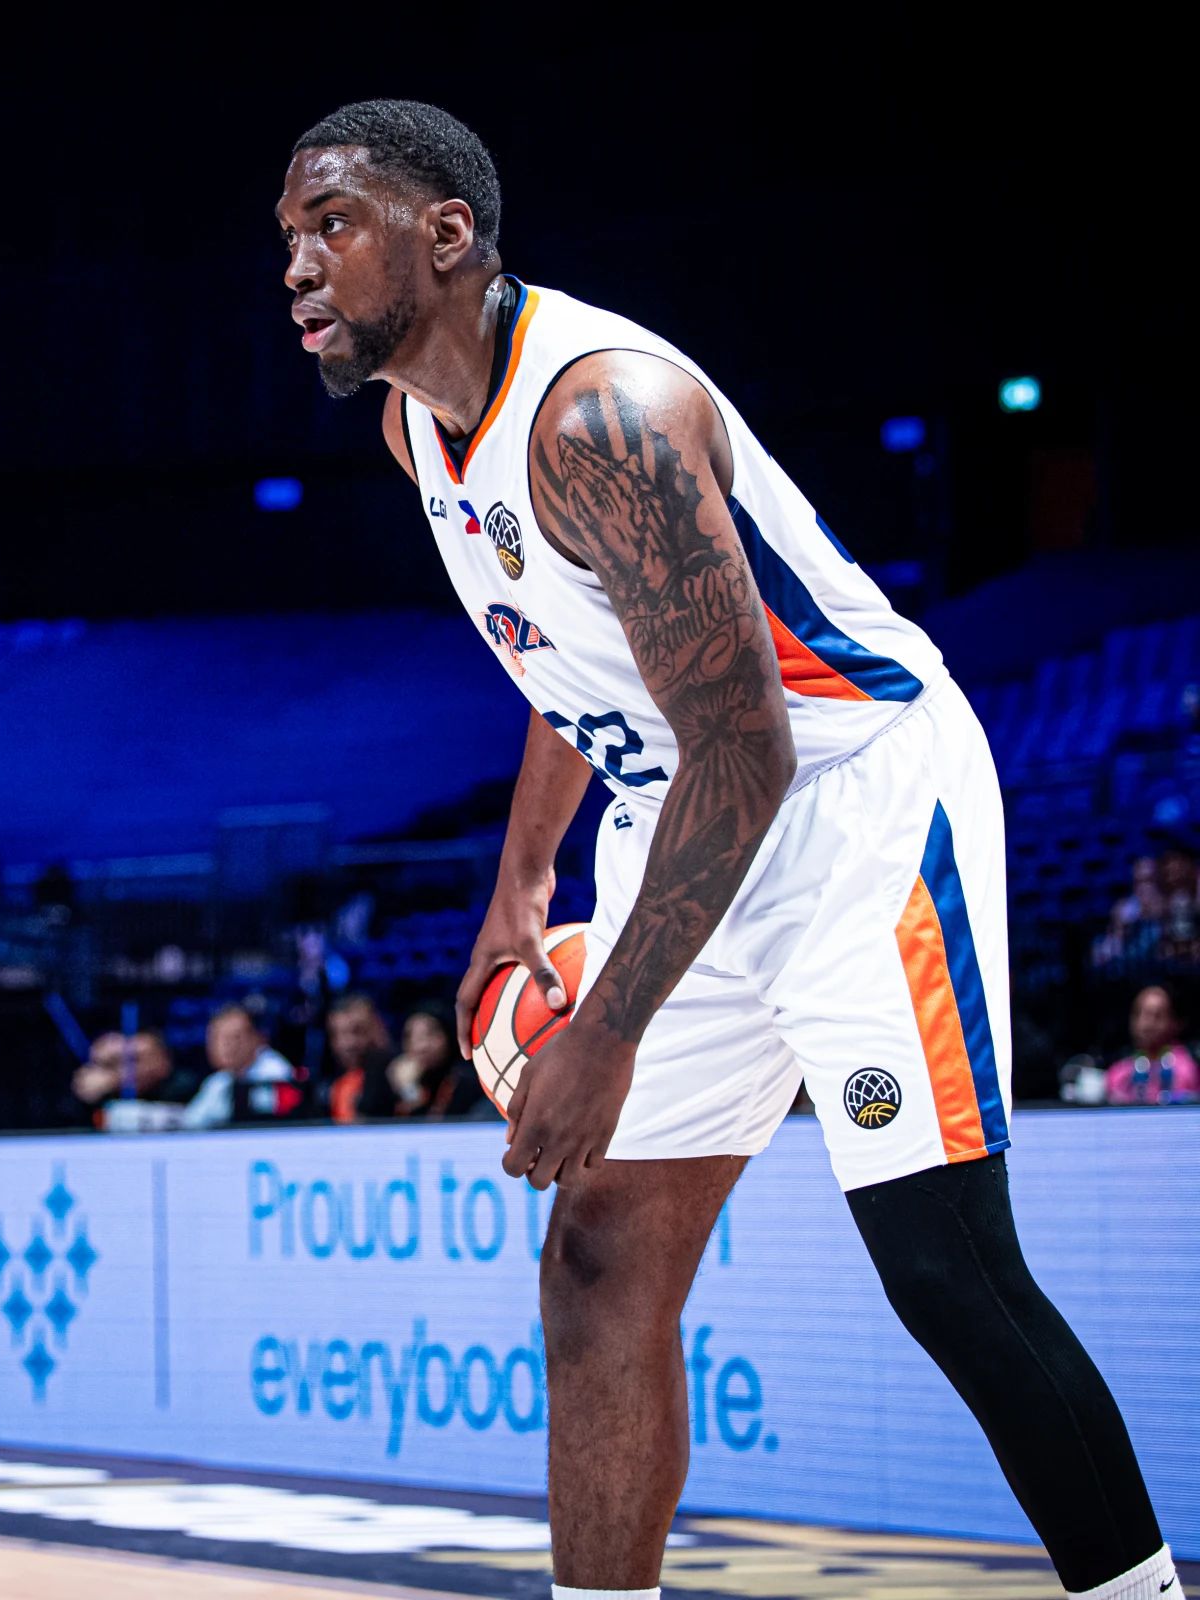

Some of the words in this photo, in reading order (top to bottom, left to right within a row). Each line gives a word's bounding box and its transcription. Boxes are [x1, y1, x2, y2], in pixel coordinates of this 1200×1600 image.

[249, 1154, 420, 1260] Proud
[440, 1158, 506, 1262] to
[251, 1314, 549, 1457] everybod
